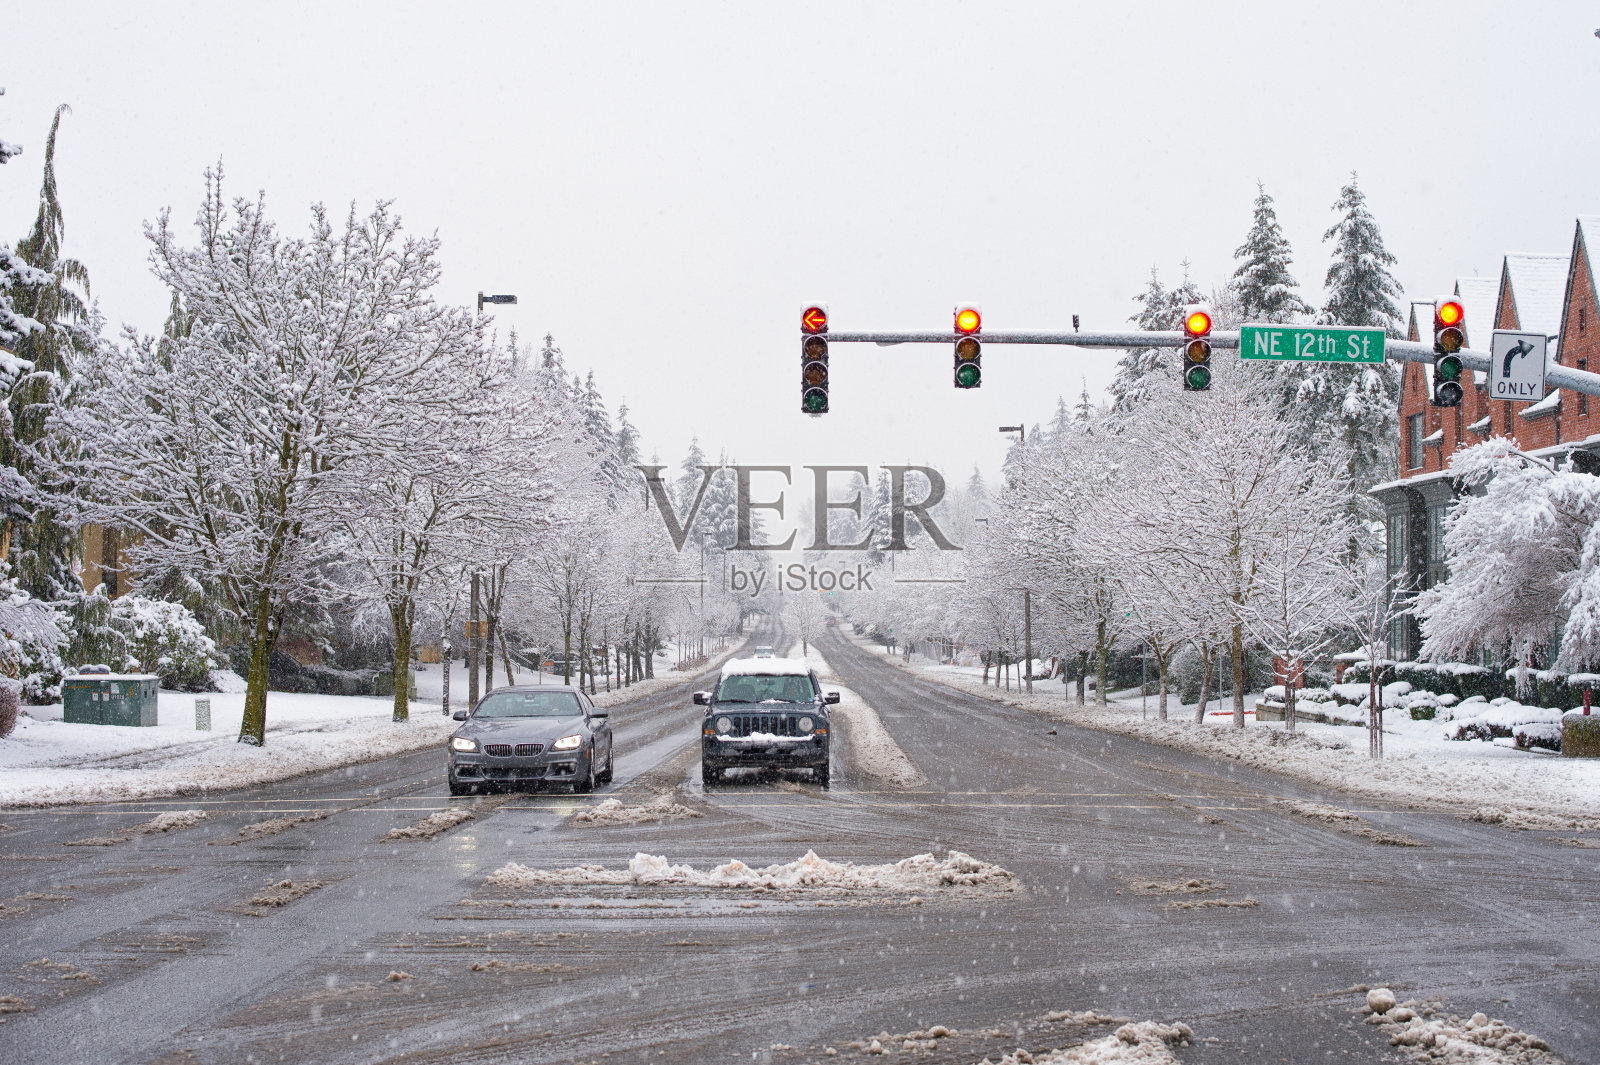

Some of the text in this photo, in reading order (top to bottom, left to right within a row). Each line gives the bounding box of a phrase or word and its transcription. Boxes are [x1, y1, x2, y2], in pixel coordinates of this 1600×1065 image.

[1254, 332, 1371, 359] NE 12th St
[1497, 381, 1537, 396] ONLY
